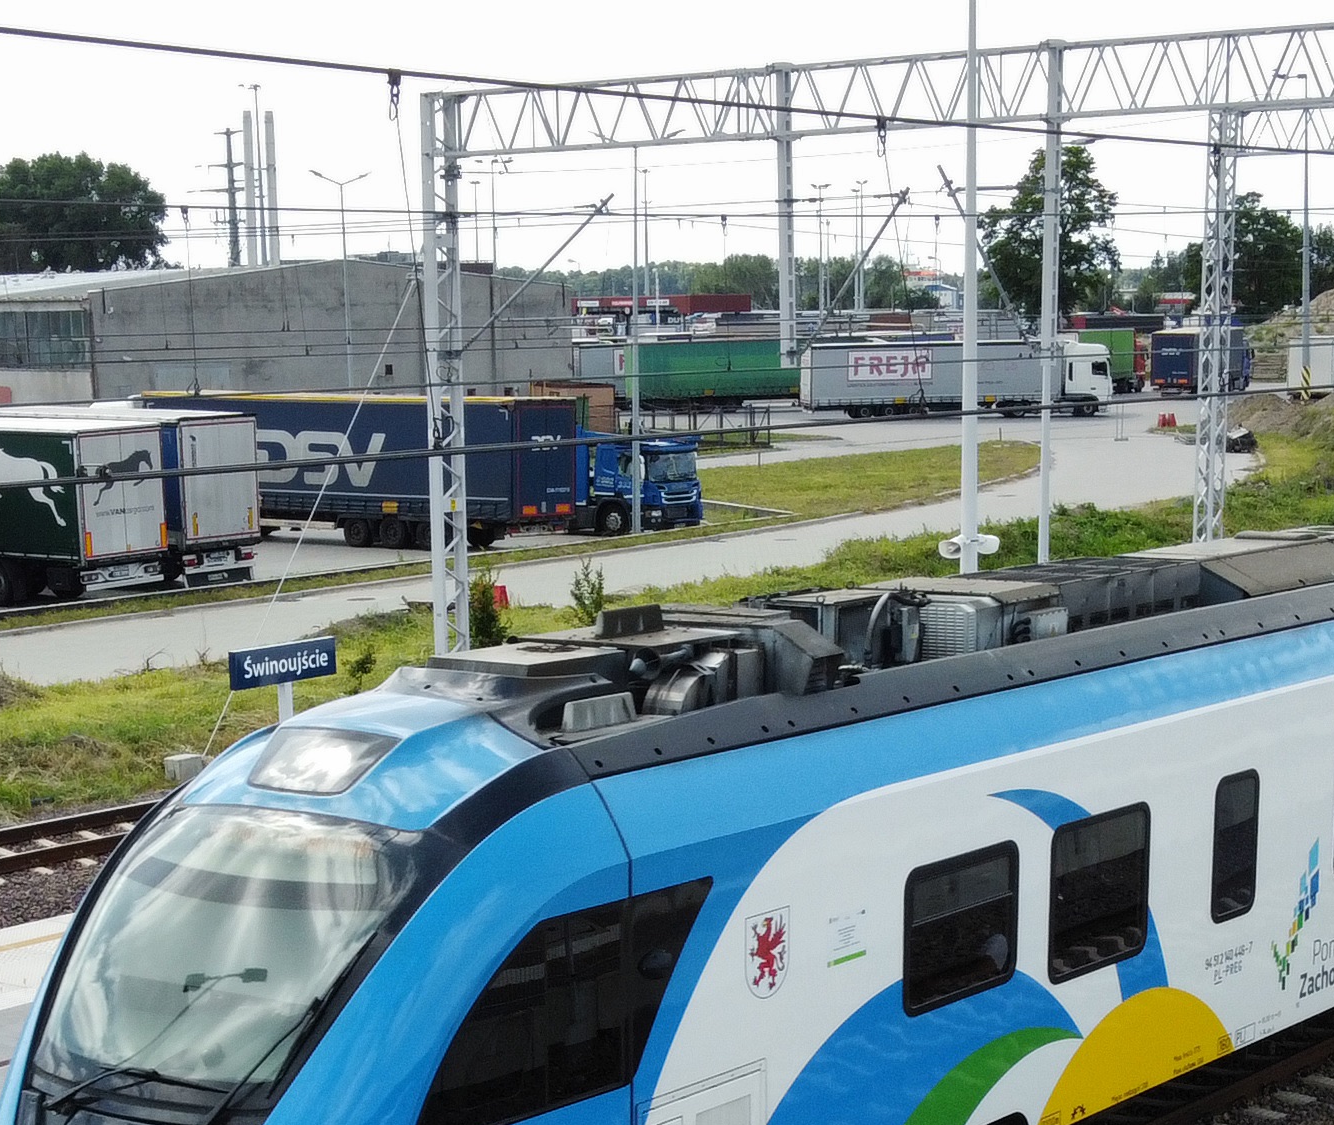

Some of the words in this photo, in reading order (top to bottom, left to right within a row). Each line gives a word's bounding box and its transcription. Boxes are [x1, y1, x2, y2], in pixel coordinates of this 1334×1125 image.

[853, 354, 927, 378] FREJA
[256, 429, 386, 487] DSV
[244, 649, 329, 679] Świnoujście
